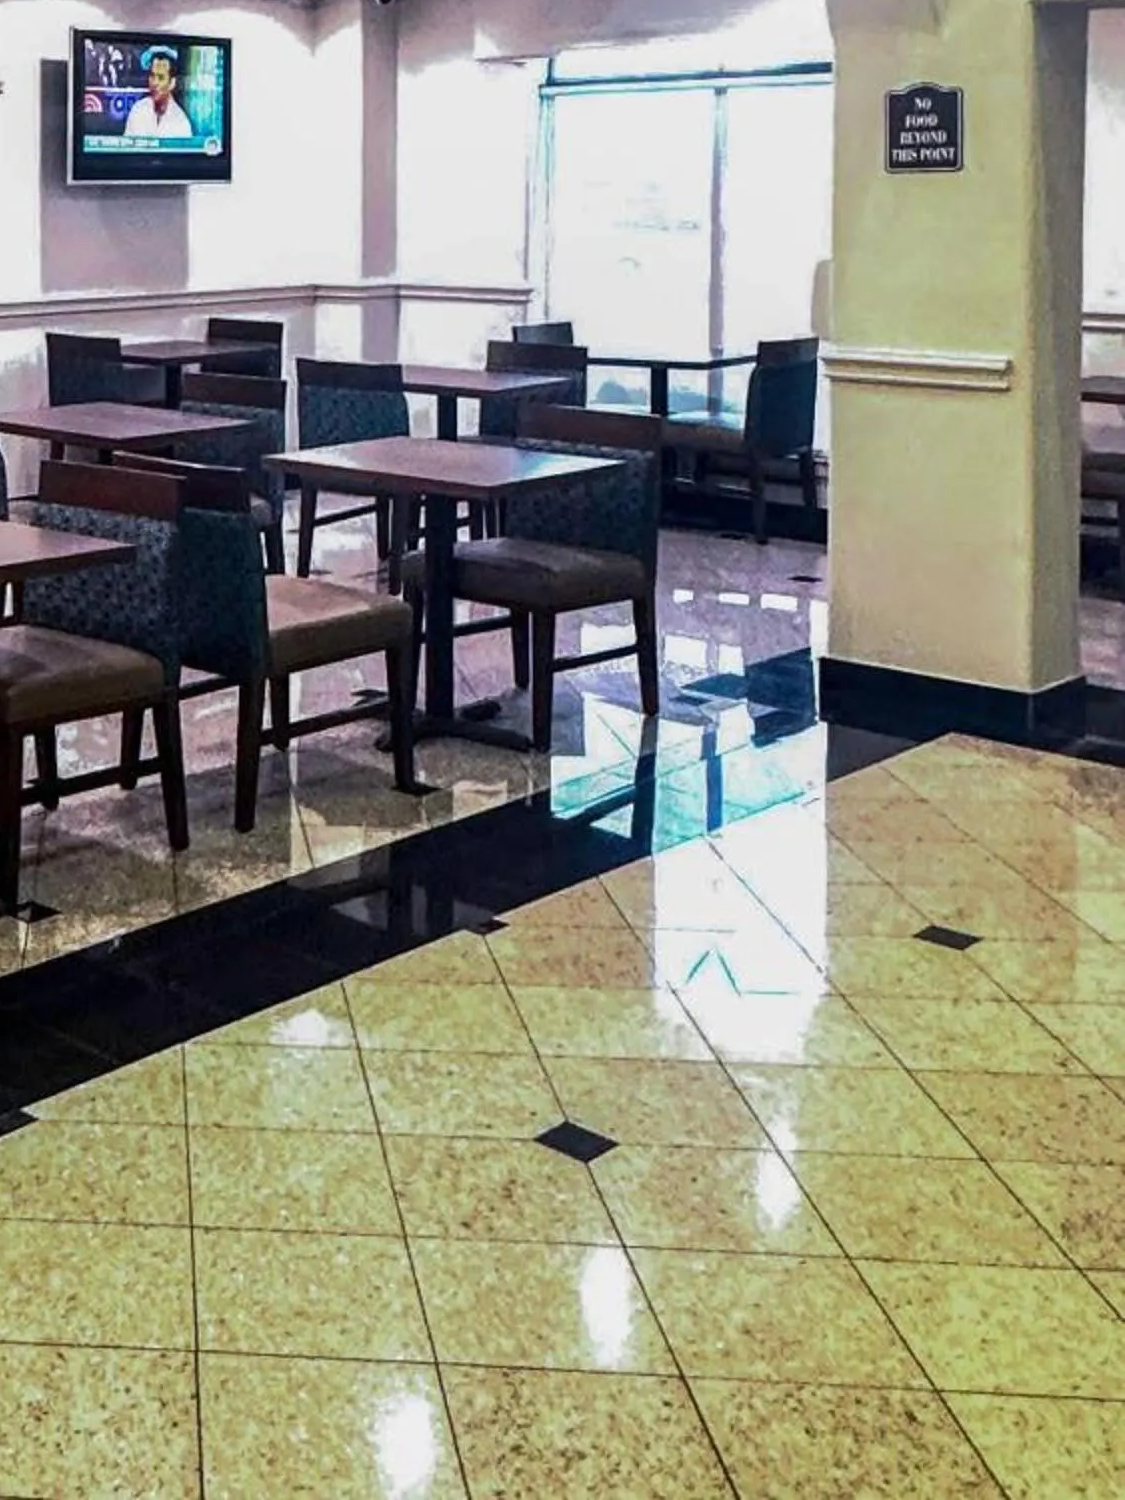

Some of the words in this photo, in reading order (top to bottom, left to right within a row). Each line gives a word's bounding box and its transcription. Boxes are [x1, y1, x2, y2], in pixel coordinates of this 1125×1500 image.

[915, 97, 933, 111] NO
[905, 113, 939, 129] FOOD
[900, 130, 949, 145] BEYOND
[891, 148, 918, 163] THIS
[920, 147, 956, 161] POINT
